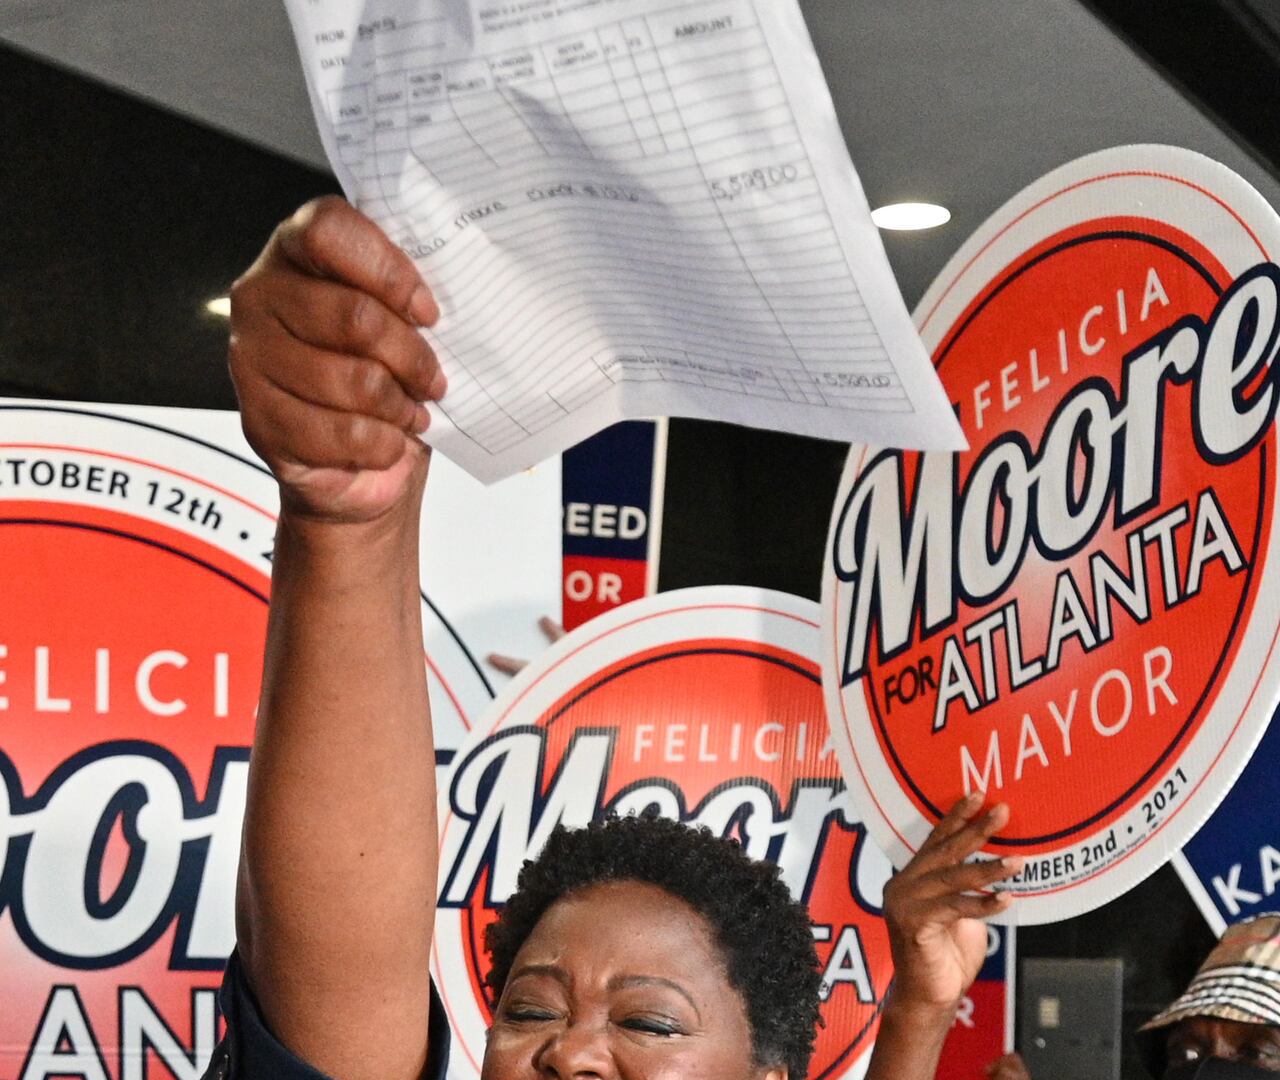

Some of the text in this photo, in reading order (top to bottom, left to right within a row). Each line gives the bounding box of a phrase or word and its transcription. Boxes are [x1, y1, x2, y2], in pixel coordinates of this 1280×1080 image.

[974, 267, 1170, 429] FELICIA
[145, 480, 224, 531] 12th
[562, 502, 647, 540] EED
[884, 487, 1249, 732] FOR ATLANTA
[959, 645, 1178, 796] MAYOR
[1081, 830, 1117, 866] 2nd
[1141, 768, 1190, 823] 2021
